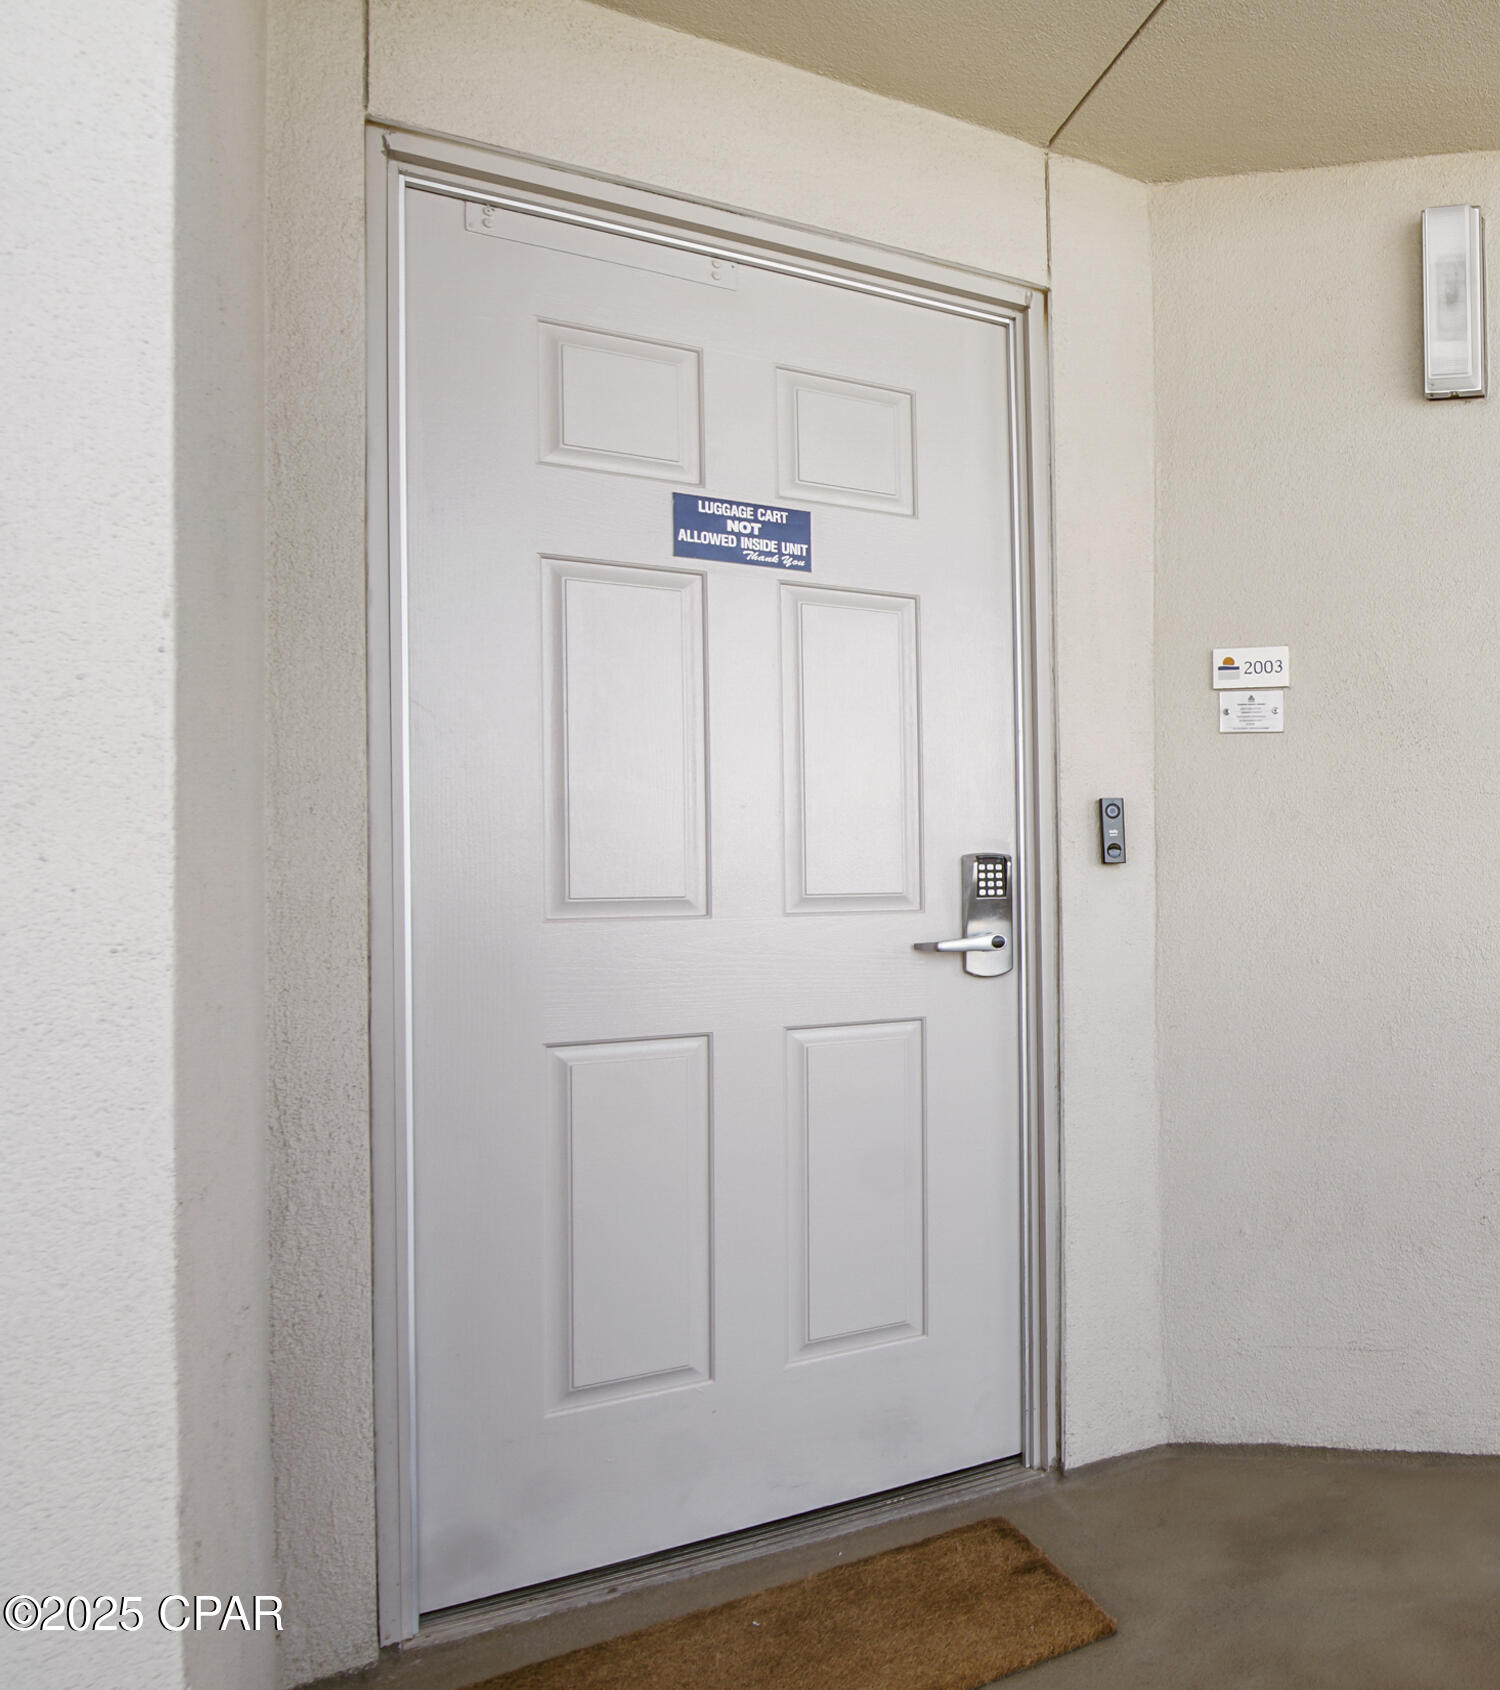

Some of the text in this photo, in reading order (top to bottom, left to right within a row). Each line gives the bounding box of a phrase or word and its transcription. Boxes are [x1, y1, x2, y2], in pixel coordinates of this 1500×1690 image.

[698, 500, 788, 524] LUGGAGE CART
[726, 519, 762, 535] NOT
[678, 528, 808, 557] ALLOWED INSIDE UNIT
[742, 550, 806, 568] Thank You
[1243, 659, 1283, 675] 2003
